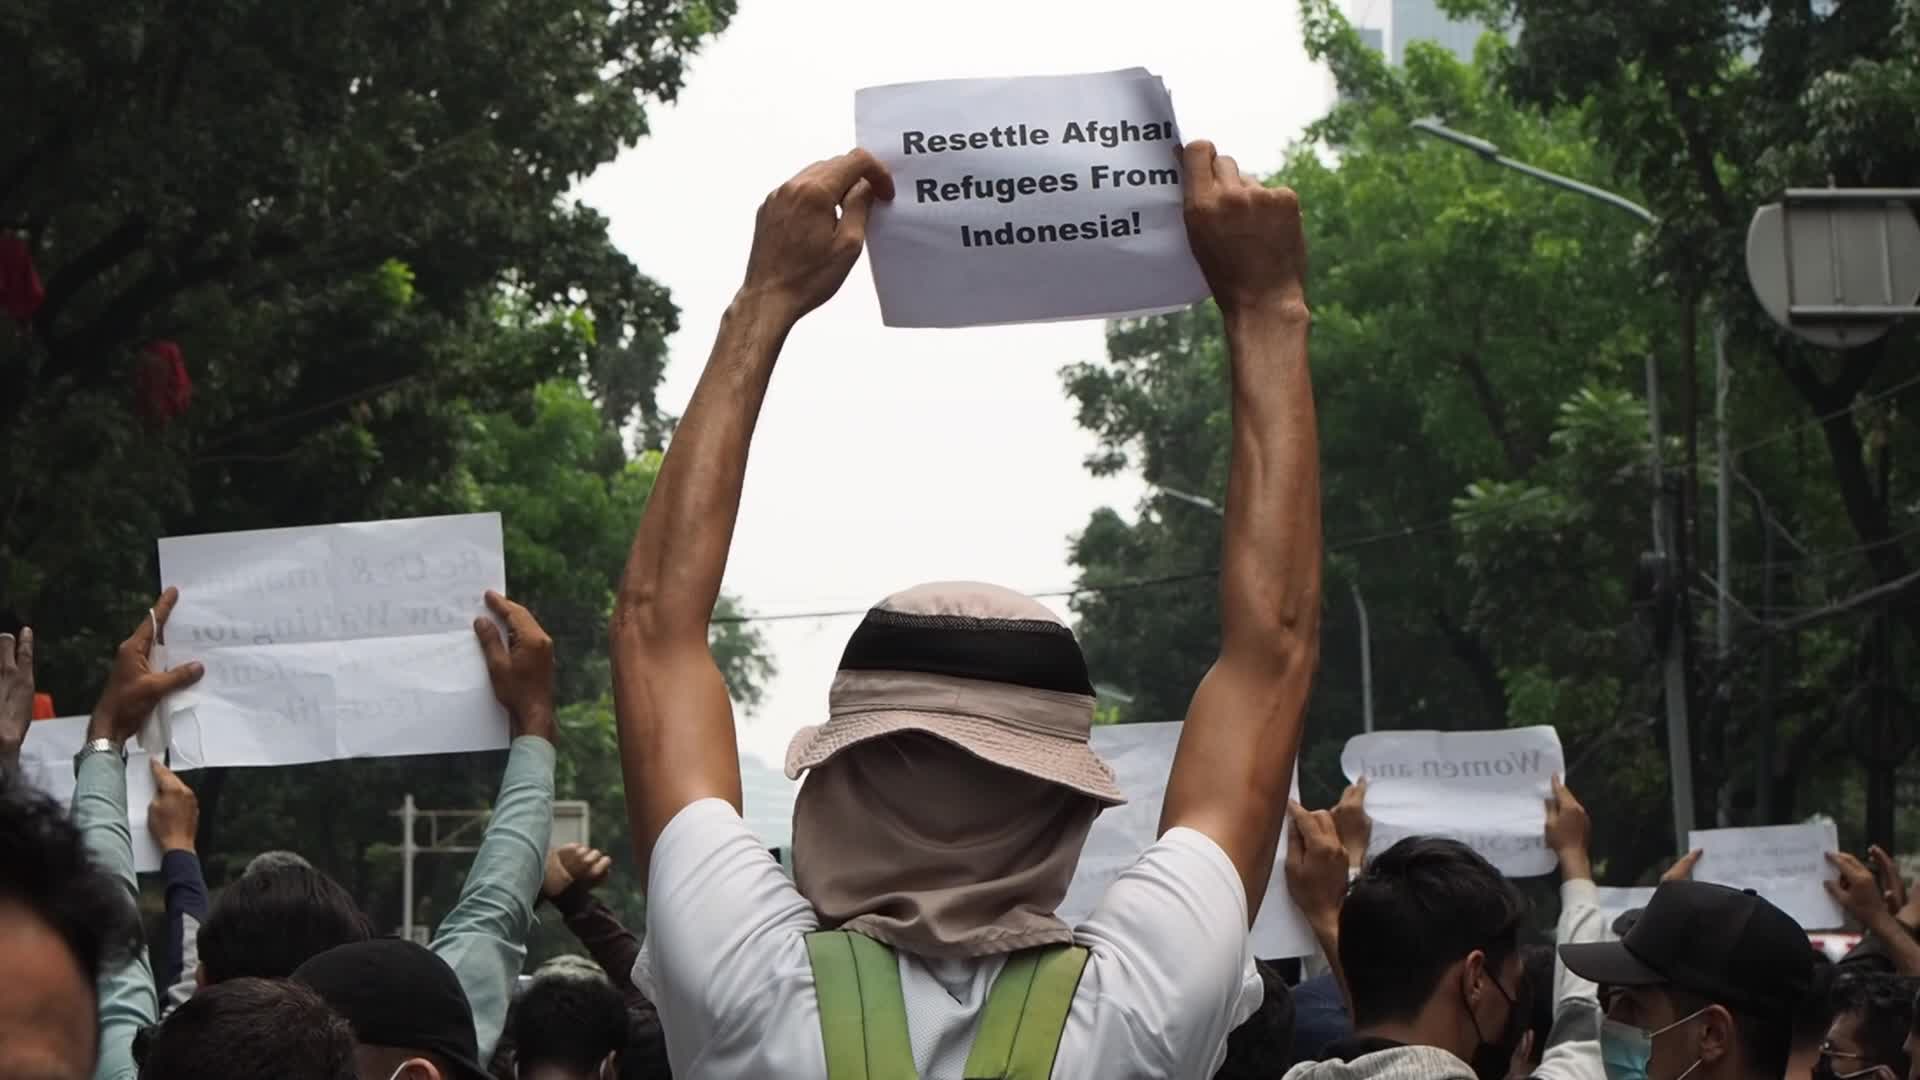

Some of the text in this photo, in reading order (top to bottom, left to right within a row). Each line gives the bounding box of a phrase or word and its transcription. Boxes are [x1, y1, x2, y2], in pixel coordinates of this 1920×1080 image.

[902, 123, 1050, 155] Resettle
[915, 164, 1178, 204] Refugees From
[960, 211, 1142, 248] Indonesia!
